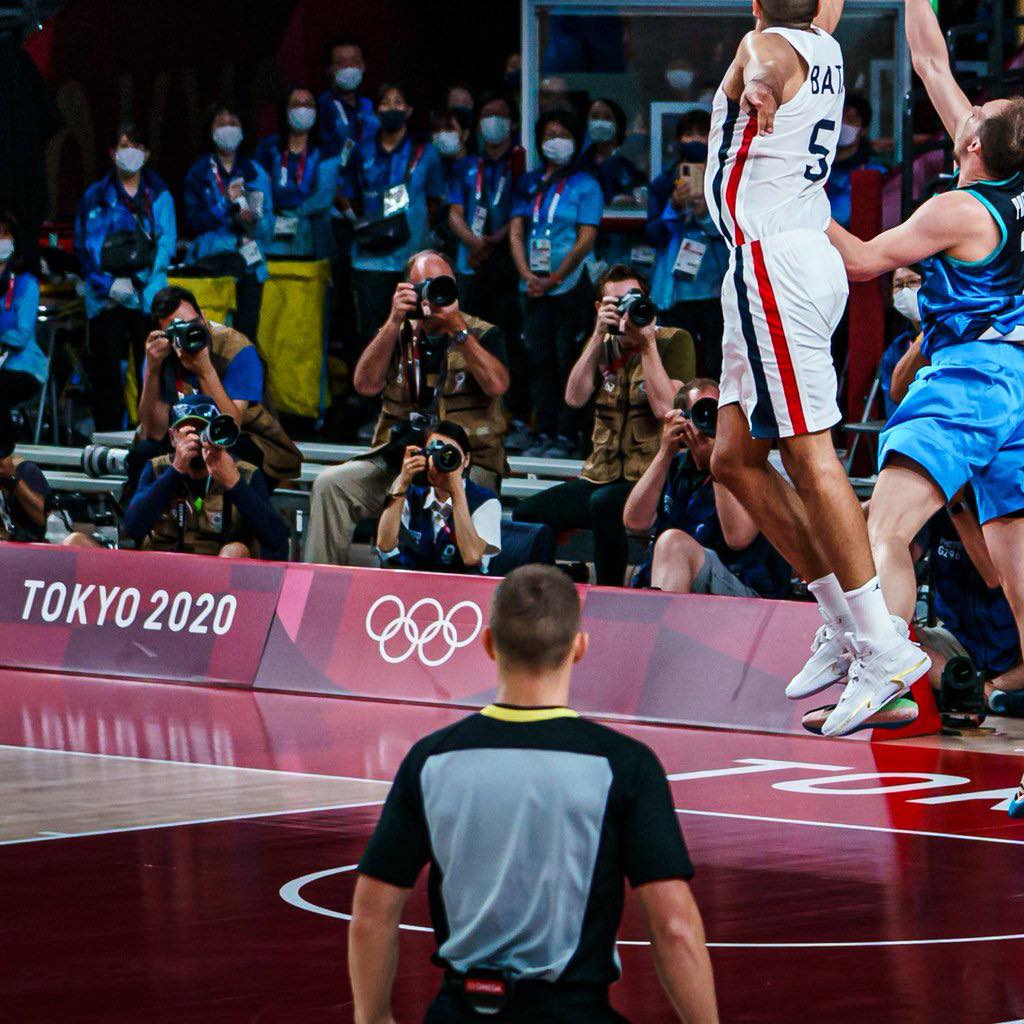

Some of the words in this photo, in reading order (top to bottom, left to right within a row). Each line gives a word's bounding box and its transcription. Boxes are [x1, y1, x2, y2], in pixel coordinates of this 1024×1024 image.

[810, 65, 843, 95] BAT
[804, 119, 836, 183] 5
[21, 579, 141, 628] TOKYO
[143, 589, 237, 635] 2020
